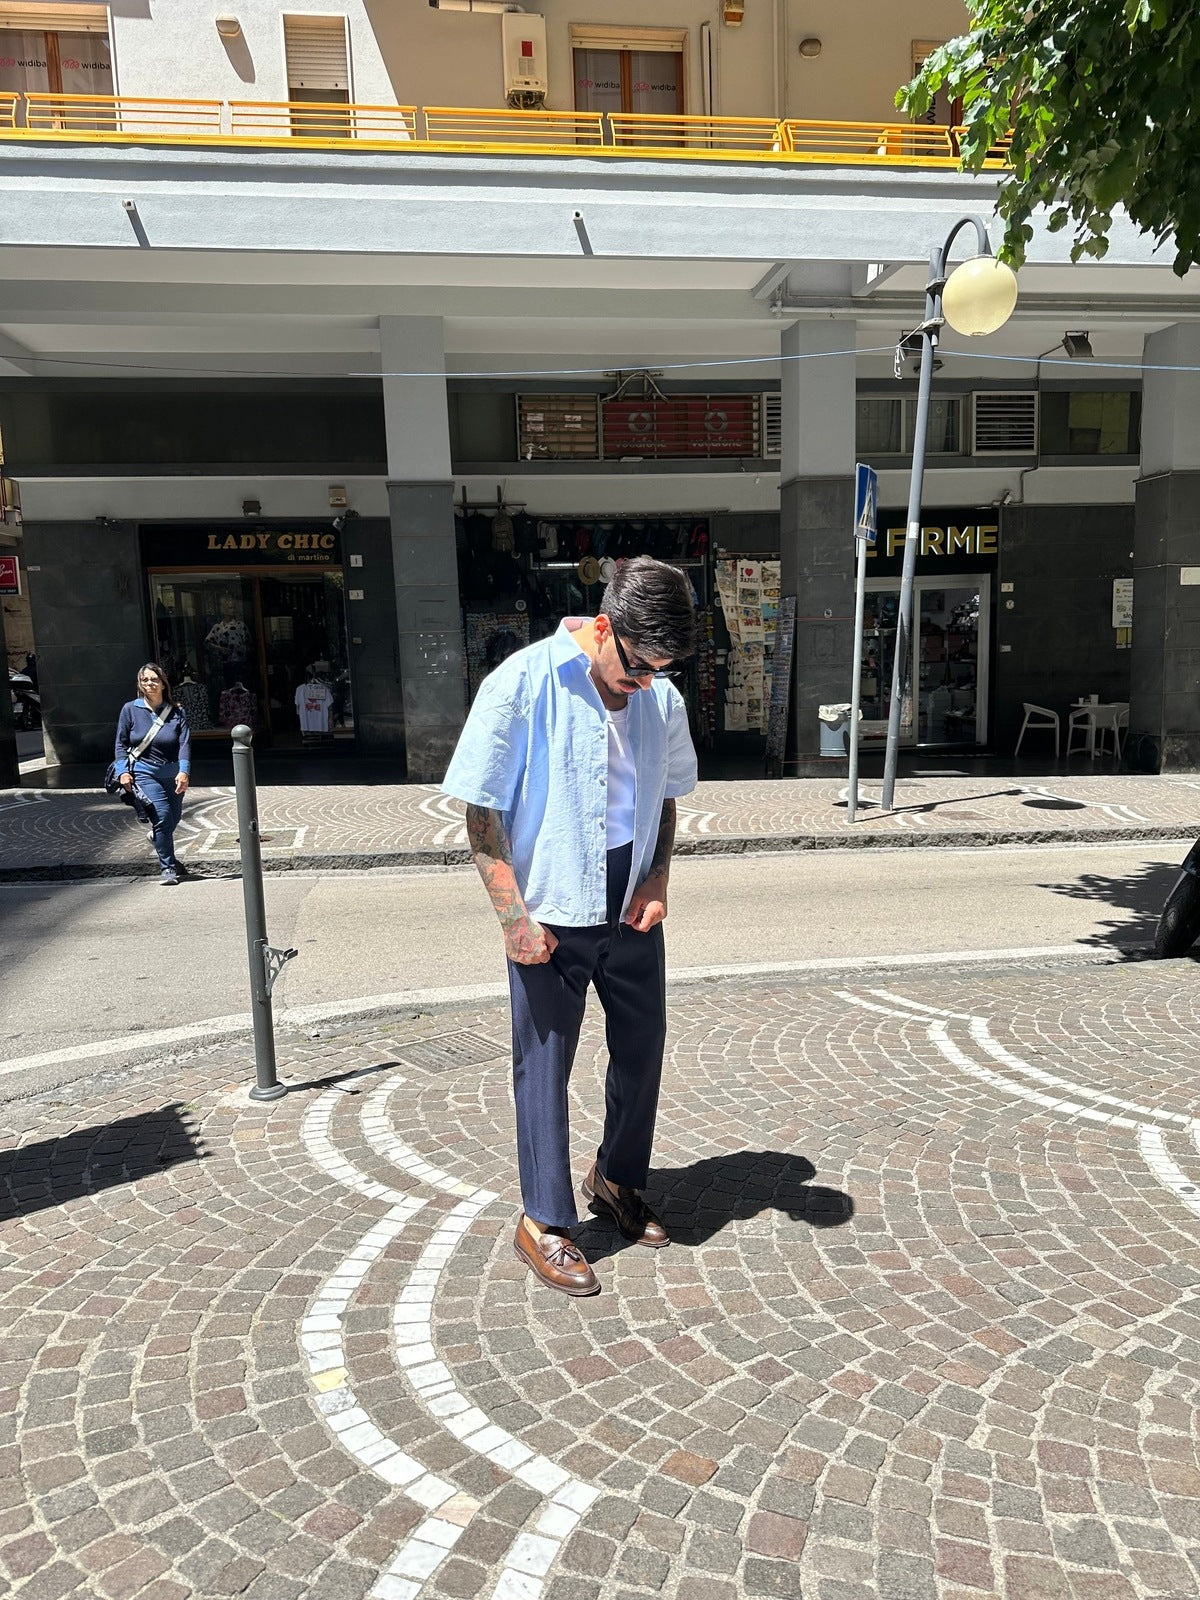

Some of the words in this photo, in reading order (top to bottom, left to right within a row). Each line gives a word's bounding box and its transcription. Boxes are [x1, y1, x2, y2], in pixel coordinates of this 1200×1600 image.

[17, 59, 47, 68] widiba
[81, 62, 111, 70] widiba
[594, 80, 620, 89] widiba
[650, 83, 676, 91] widiba
[207, 534, 270, 550] LADY
[277, 533, 336, 549] CHIC
[886, 525, 999, 557] FRME
[287, 553, 295, 561] di
[298, 553, 330, 561] martino
